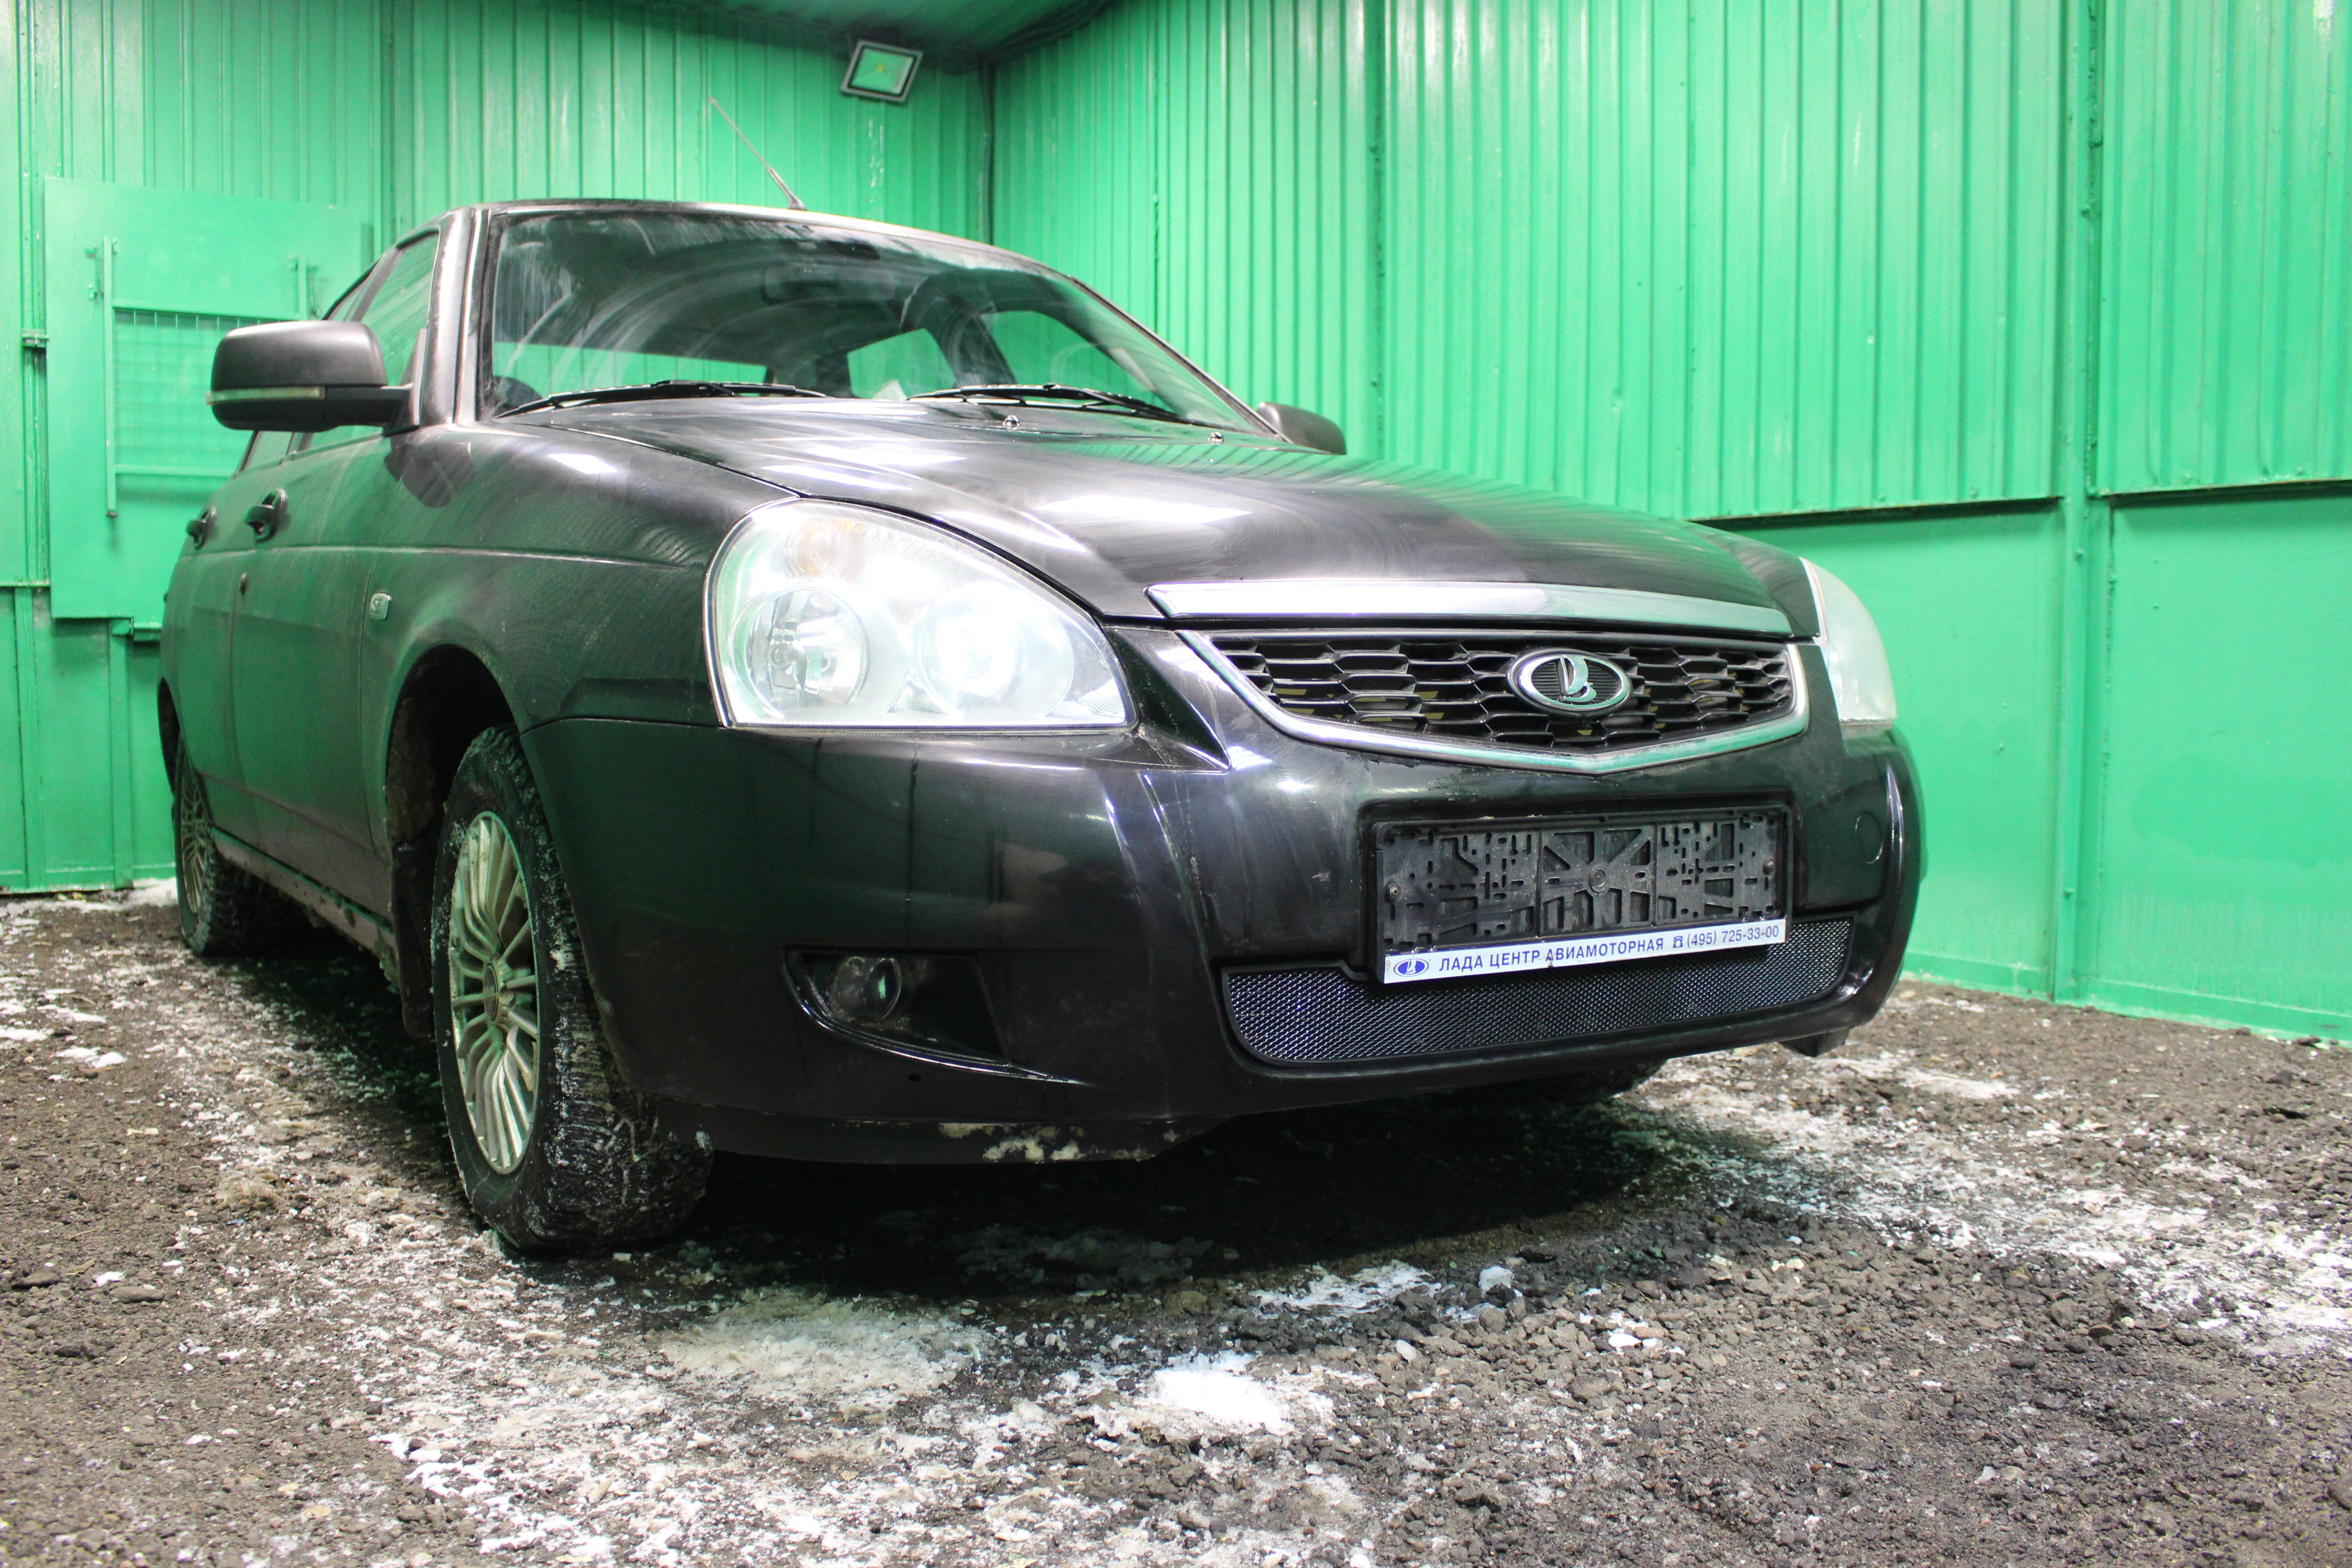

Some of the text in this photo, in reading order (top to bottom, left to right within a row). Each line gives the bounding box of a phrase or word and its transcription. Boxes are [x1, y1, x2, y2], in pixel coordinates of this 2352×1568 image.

[1440, 925, 1779, 972] ЛАДА ЦЕНТР АВИАМОТОРНАЯ (495) 725-33-00
